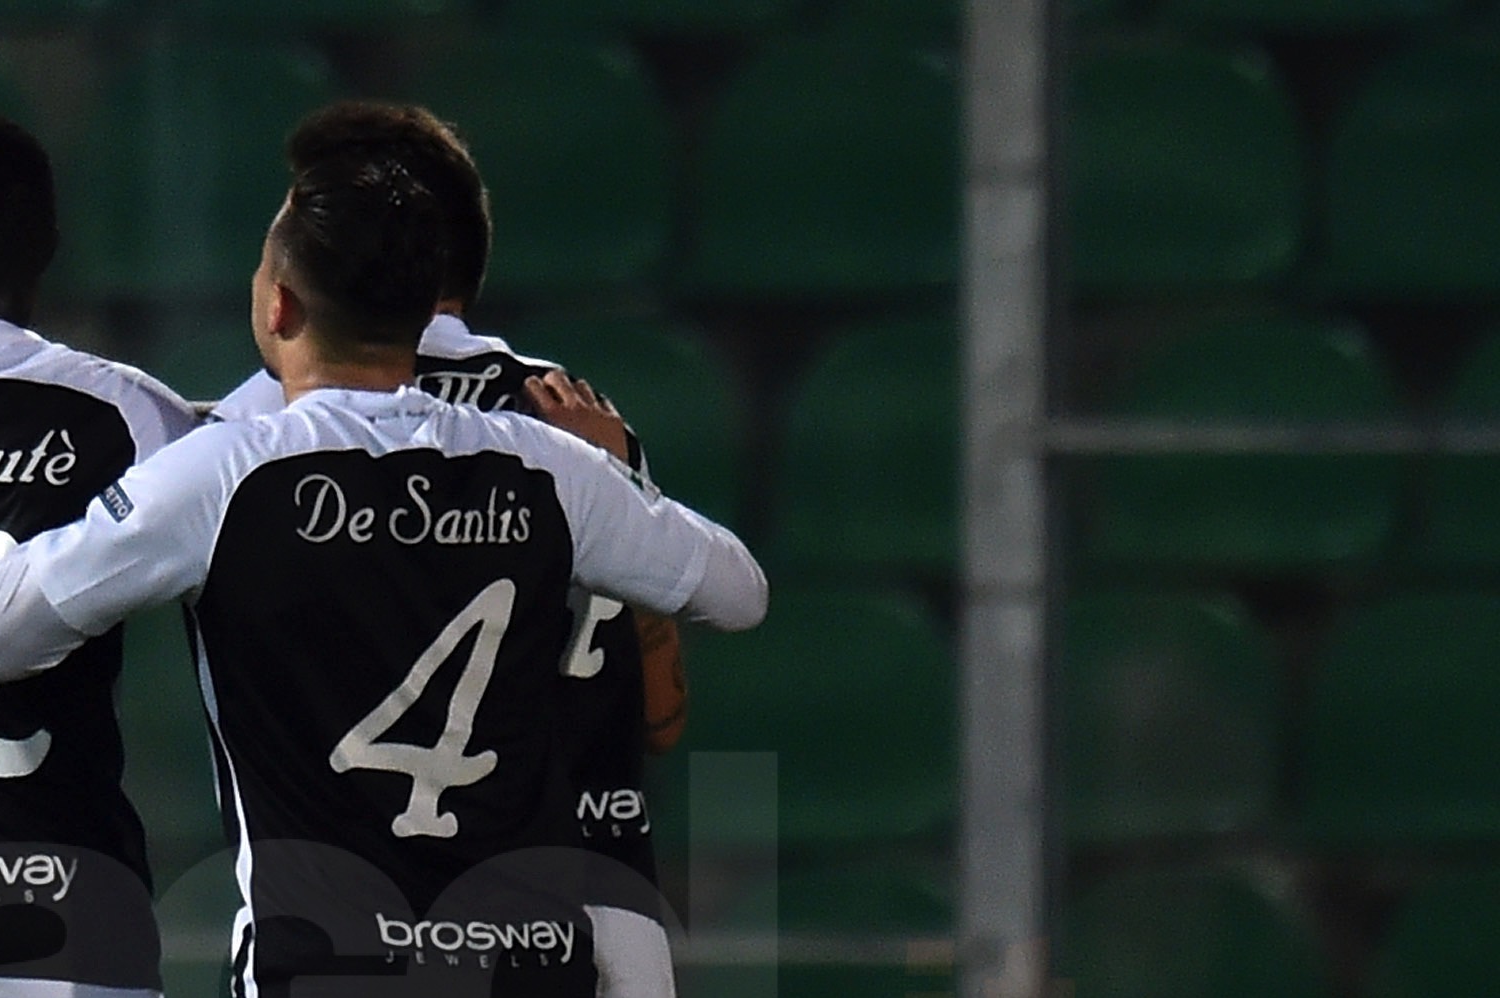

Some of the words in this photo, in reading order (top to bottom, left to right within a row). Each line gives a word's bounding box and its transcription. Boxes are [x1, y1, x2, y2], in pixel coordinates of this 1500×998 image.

[293, 472, 375, 544] De
[388, 473, 534, 545] Santis
[329, 577, 516, 838] 4
[375, 911, 575, 964] brosway
